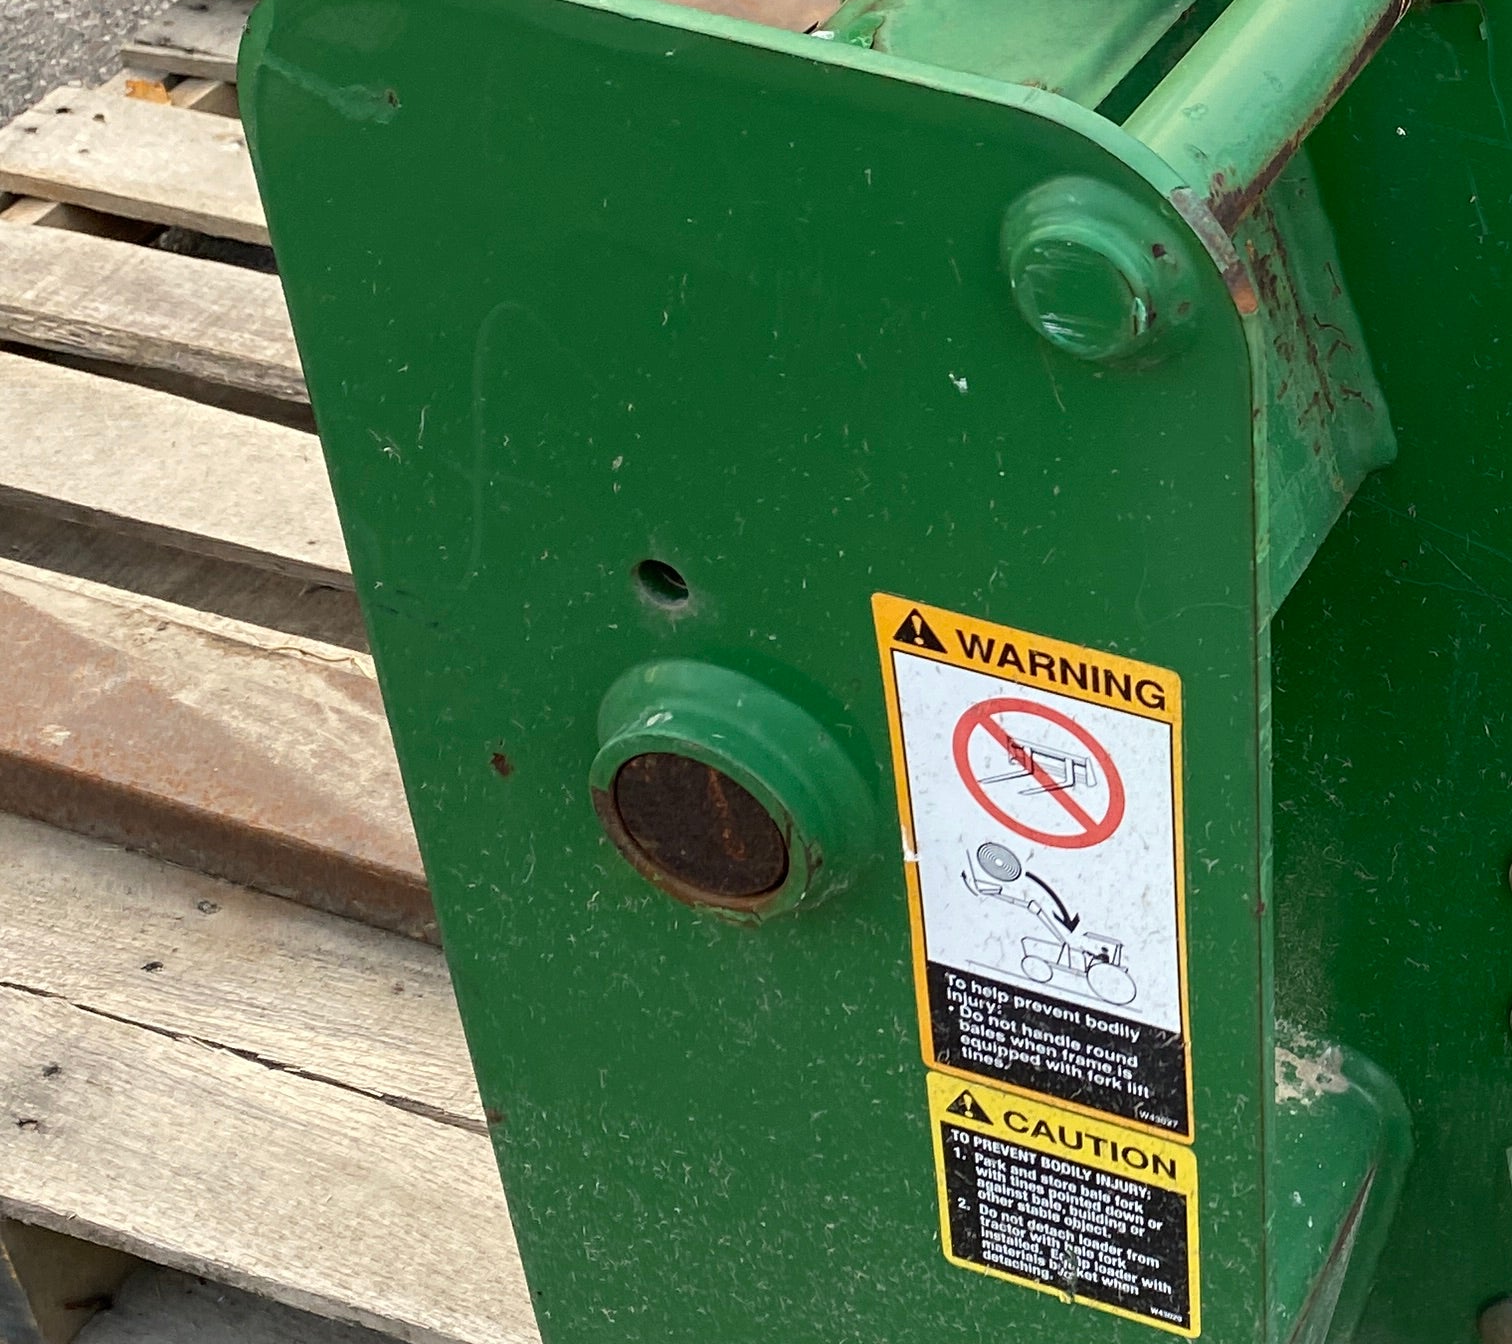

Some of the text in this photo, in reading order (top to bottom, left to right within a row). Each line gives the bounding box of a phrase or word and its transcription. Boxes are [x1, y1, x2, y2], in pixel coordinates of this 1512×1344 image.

[955, 629, 1166, 711] WARNING
[947, 987, 1002, 1014] injury:
[949, 974, 1140, 1043] To help prevent bodily
[960, 1005, 1138, 1068] Do not handle round
[960, 1019, 1132, 1080] bales when frame is
[960, 1035, 1150, 1099] equipped with fork lift
[951, 1129, 1151, 1200] TO PREVENT BODILY INJURY:
[1003, 1111, 1176, 1180] CAUTION
[953, 1147, 1143, 1214] 1. Park and store bale fork
[975, 1166, 1163, 1231] with tines pointed down or
[977, 1178, 1145, 1236] against bale, building or
[958, 1197, 1160, 1268] 2. Do not detach loader from
[978, 1190, 1111, 1239] other stable object.
[980, 1216, 1026, 1236] tractor
[1030, 1229, 1060, 1249] with
[1098, 1252, 1126, 1270] fork
[981, 1226, 1043, 1255] installed.
[1094, 1261, 1138, 1283] loader
[1141, 1277, 1172, 1295] with
[982, 1239, 1046, 1266] materials
[1101, 1275, 1139, 1295] when
[983, 1249, 1053, 1281] detaching.
